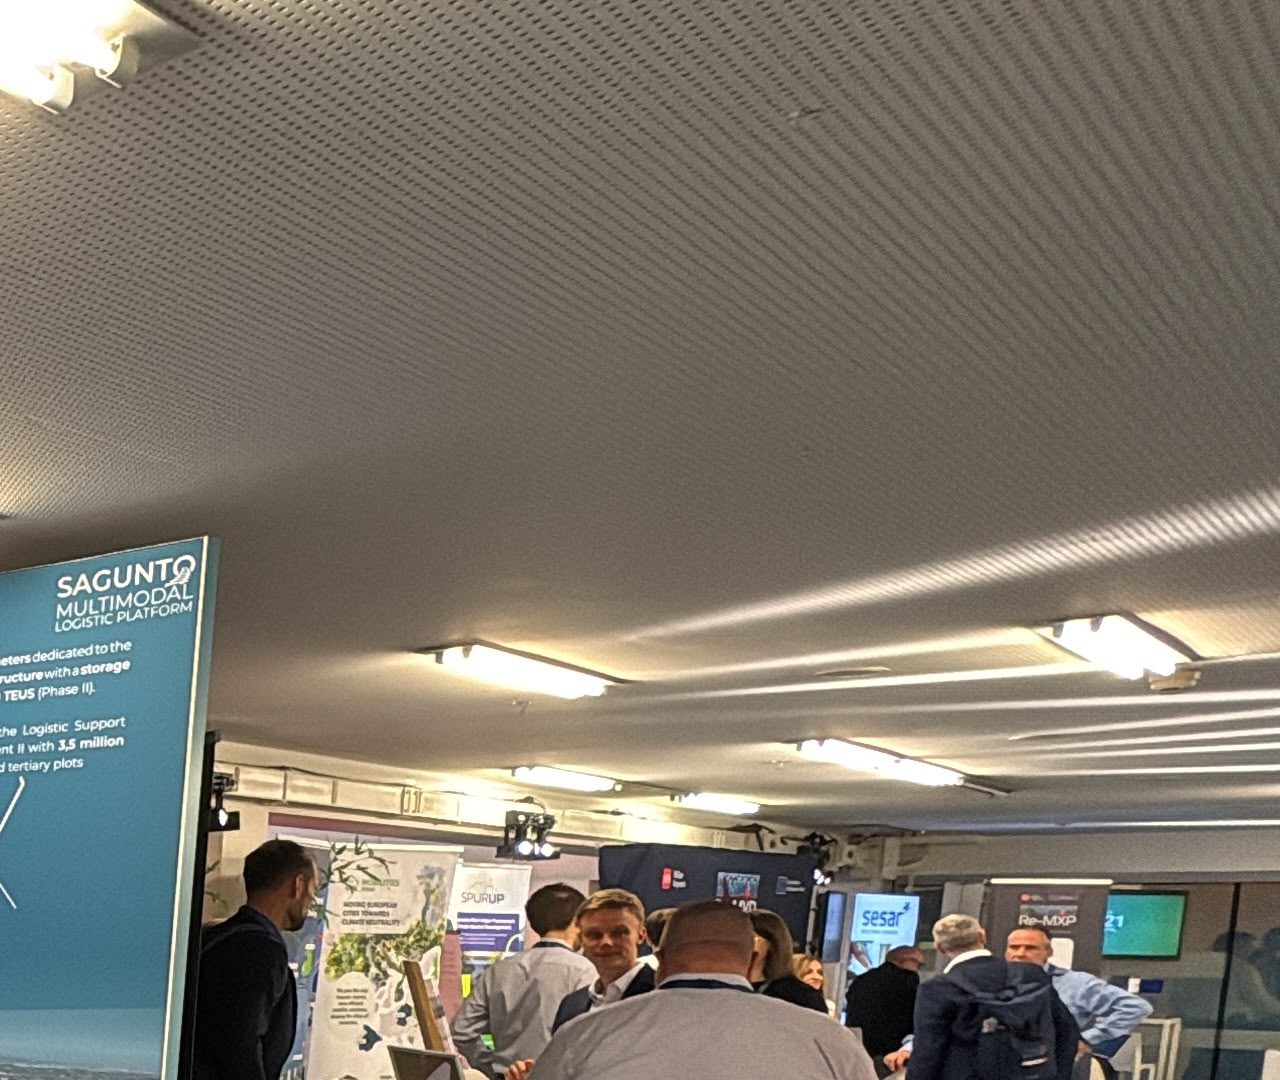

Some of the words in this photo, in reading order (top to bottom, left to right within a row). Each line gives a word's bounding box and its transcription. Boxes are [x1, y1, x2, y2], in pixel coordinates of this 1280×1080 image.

[57, 554, 196, 598] SAGUNTO
[56, 583, 194, 620] MULTIMODAL
[55, 613, 113, 633] LOGISTIC
[117, 601, 193, 623] PLATFORM
[32, 644, 93, 663] dedicated
[95, 643, 109, 655] to
[110, 640, 132, 652] the
[45, 667, 71, 680] with
[72, 667, 79, 676] a
[80, 660, 131, 676] storage
[4, 688, 36, 702] TEUS
[38, 684, 79, 701] (Phase
[22, 720, 69, 738] Logistic
[74, 716, 127, 732] Support
[28, 741, 55, 753] with
[57, 738, 76, 753] 3,5
[79, 736, 125, 750] million
[7, 758, 51, 773] tertiary
[53, 757, 84, 772] plots
[461, 892, 505, 904] SPURUP
[862, 910, 904, 927] sesar
[1018, 914, 1077, 926] Re-MXP
